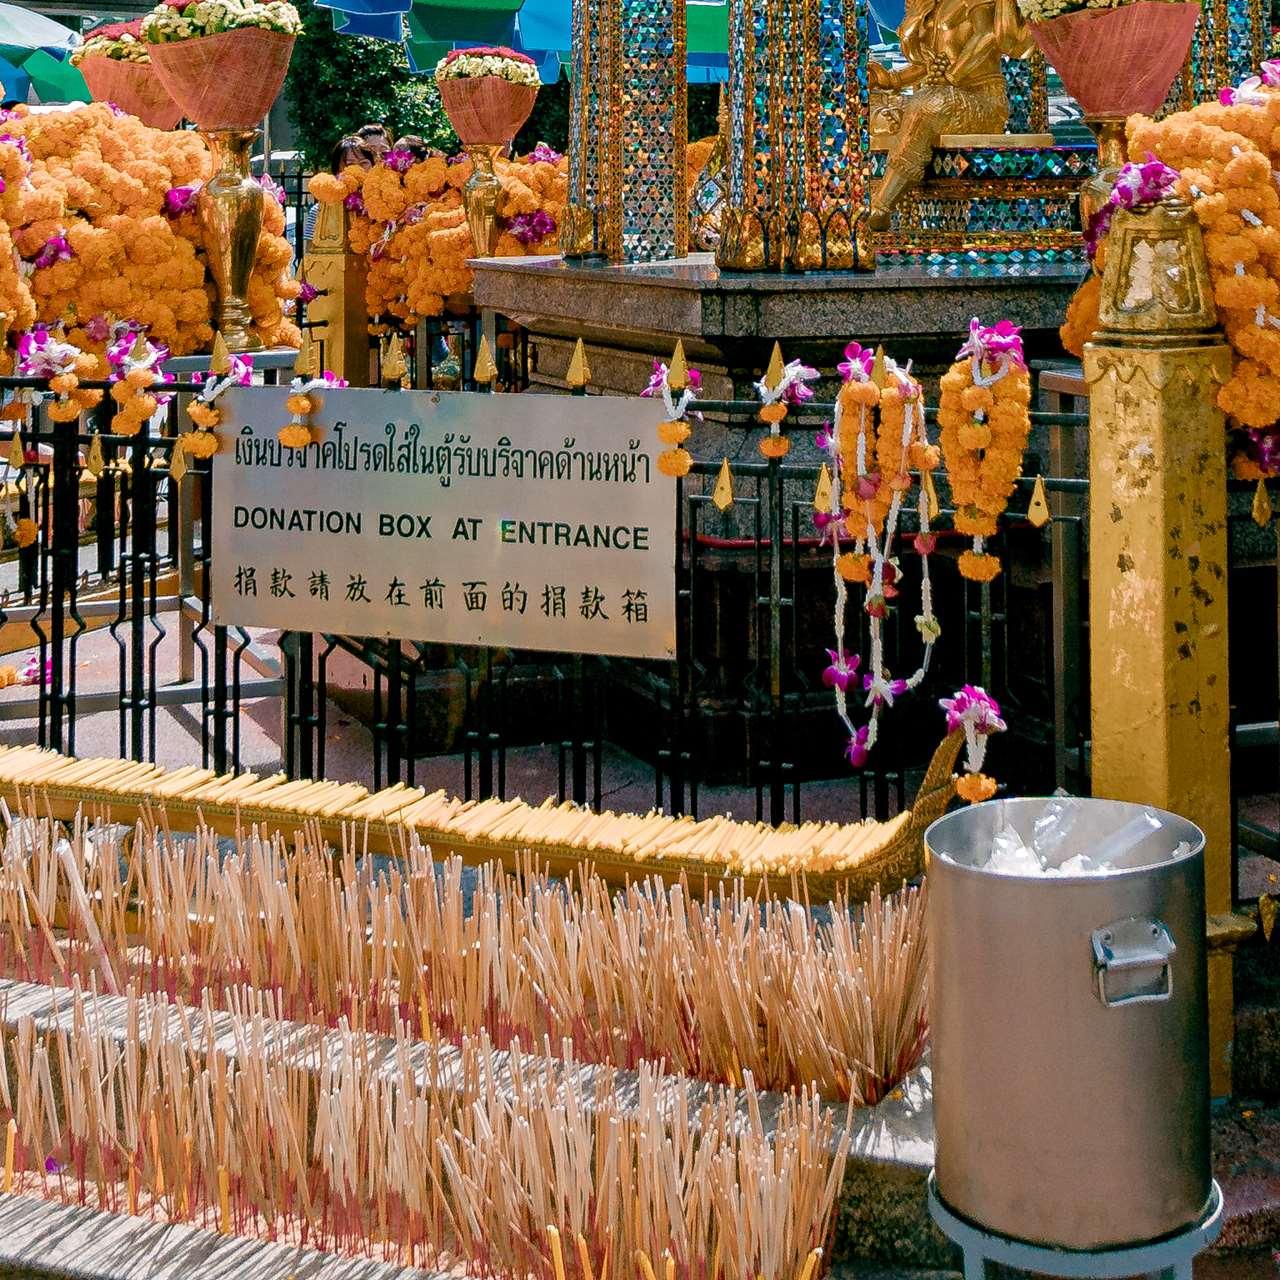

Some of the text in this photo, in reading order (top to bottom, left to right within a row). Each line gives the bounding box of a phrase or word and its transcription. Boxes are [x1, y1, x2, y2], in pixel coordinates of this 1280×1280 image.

[235, 421, 650, 488] เงินบรจาคโปรดใส่ในตู้รับบริจาคด้านหน้า
[234, 506, 649, 551] DONATION BOX AT ENTRANCE
[233, 565, 649, 624] 捐款請放在前面的捐款箱
